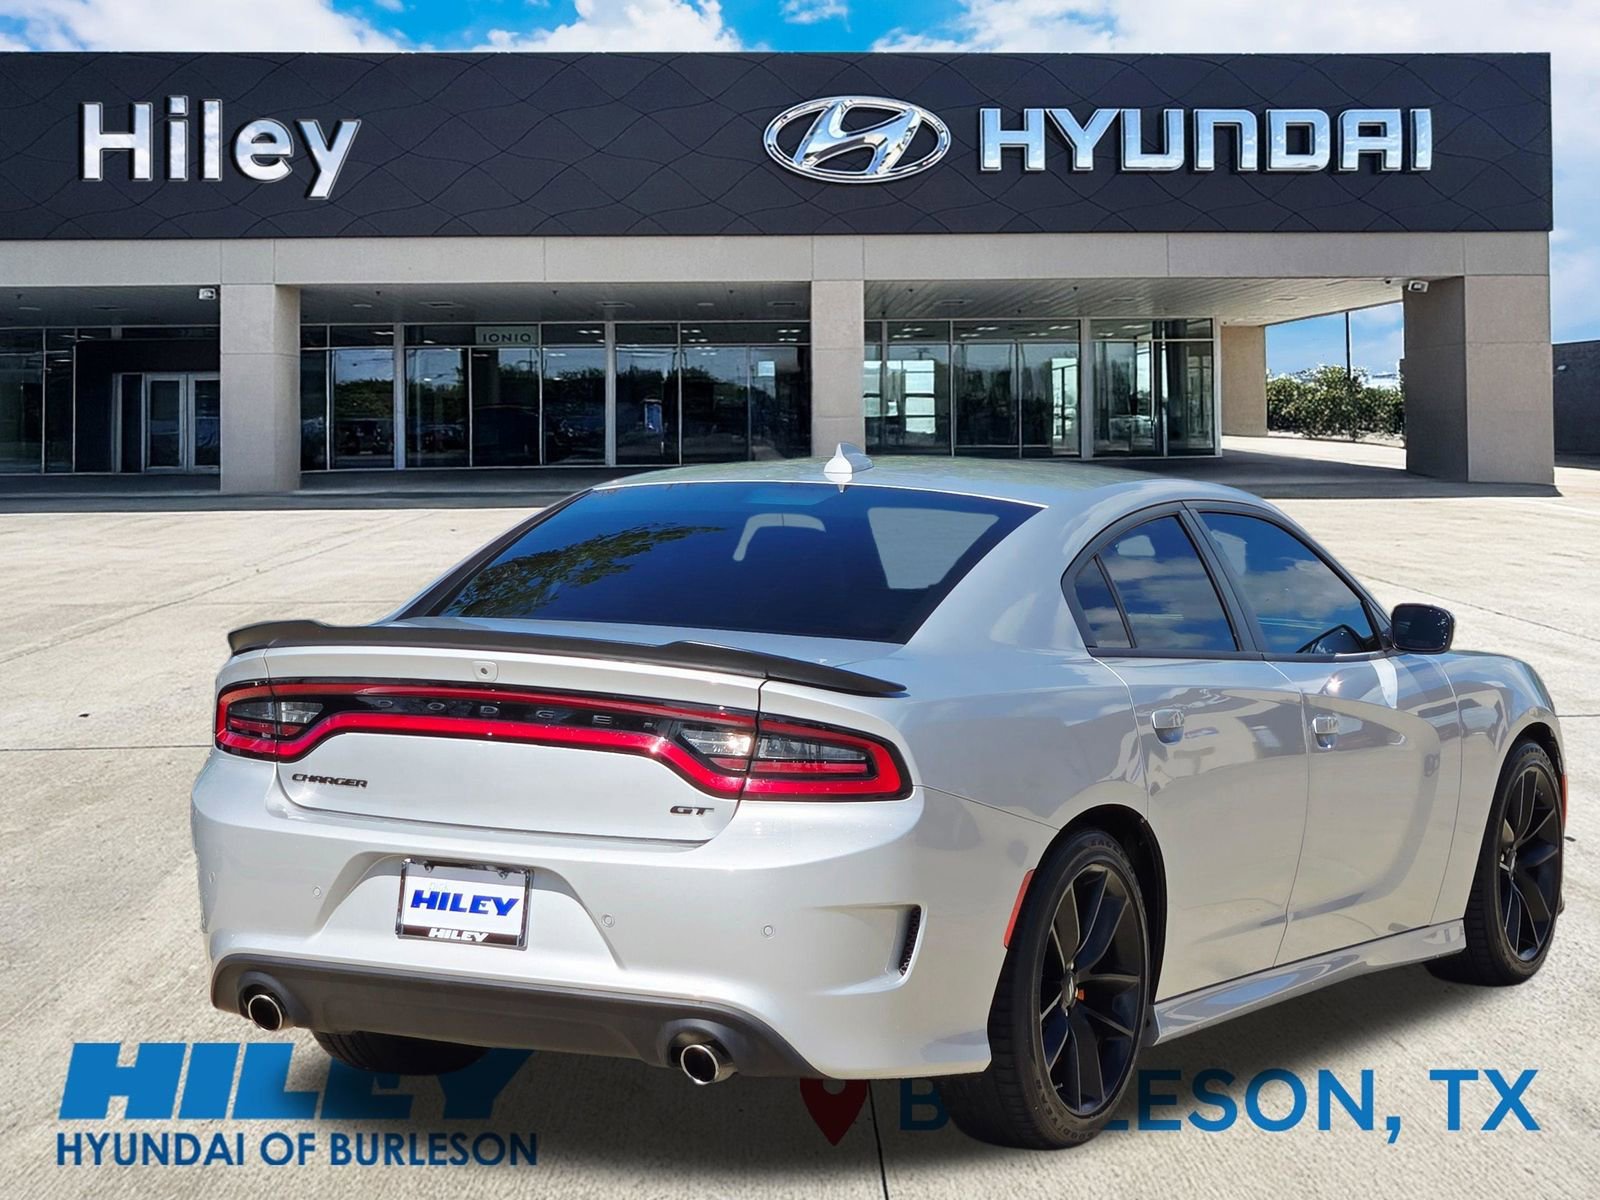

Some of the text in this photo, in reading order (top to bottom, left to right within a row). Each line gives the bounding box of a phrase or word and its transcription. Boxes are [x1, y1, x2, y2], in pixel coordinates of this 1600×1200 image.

[80, 95, 362, 199] Hiley
[979, 107, 1432, 172] HYUNDAI
[378, 699, 612, 725] DODGE
[292, 773, 368, 788] CHARGER
[670, 805, 715, 816] GT
[410, 889, 519, 917] HILEY
[428, 927, 488, 942] HILEY
